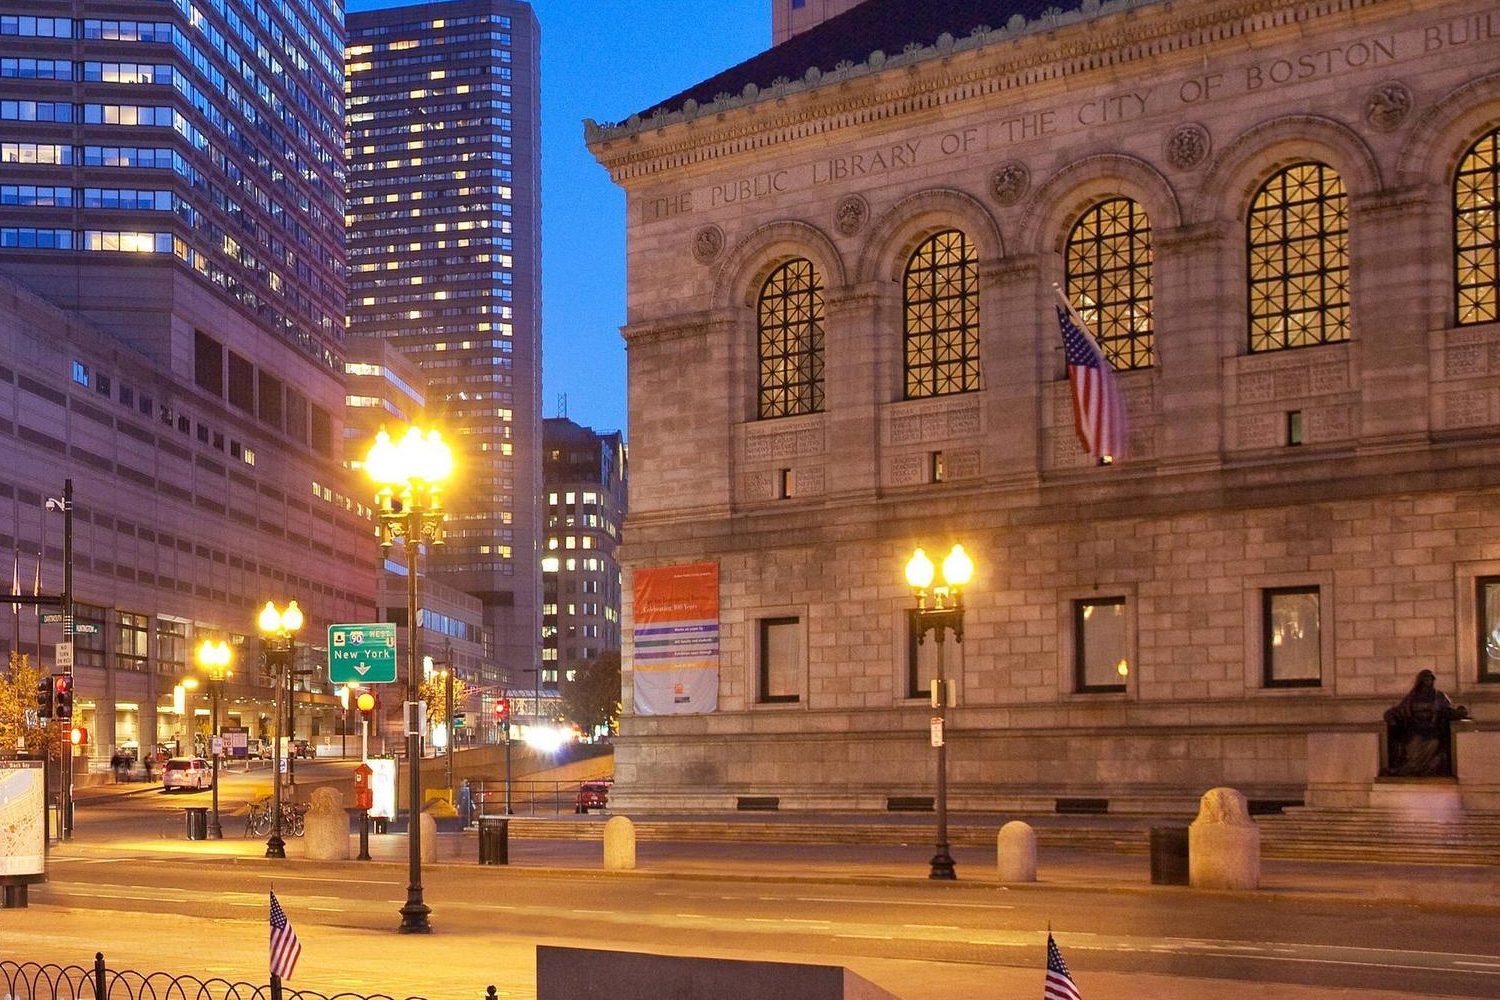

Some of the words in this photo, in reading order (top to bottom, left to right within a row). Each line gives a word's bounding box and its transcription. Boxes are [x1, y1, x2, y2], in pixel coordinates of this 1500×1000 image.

[651, 192, 693, 219] THE
[711, 171, 789, 206] PUBLIC
[811, 140, 922, 184] LIBRARY
[940, 128, 978, 155] OF
[1000, 110, 1057, 142] THE
[1077, 89, 1153, 126] CITY
[1179, 73, 1224, 103] OF
[1246, 35, 1396, 91] BOSTON
[351, 635, 362, 643] 90
[369, 630, 390, 638] WEST
[334, 650, 358, 659] New
[364, 649, 390, 659] York
